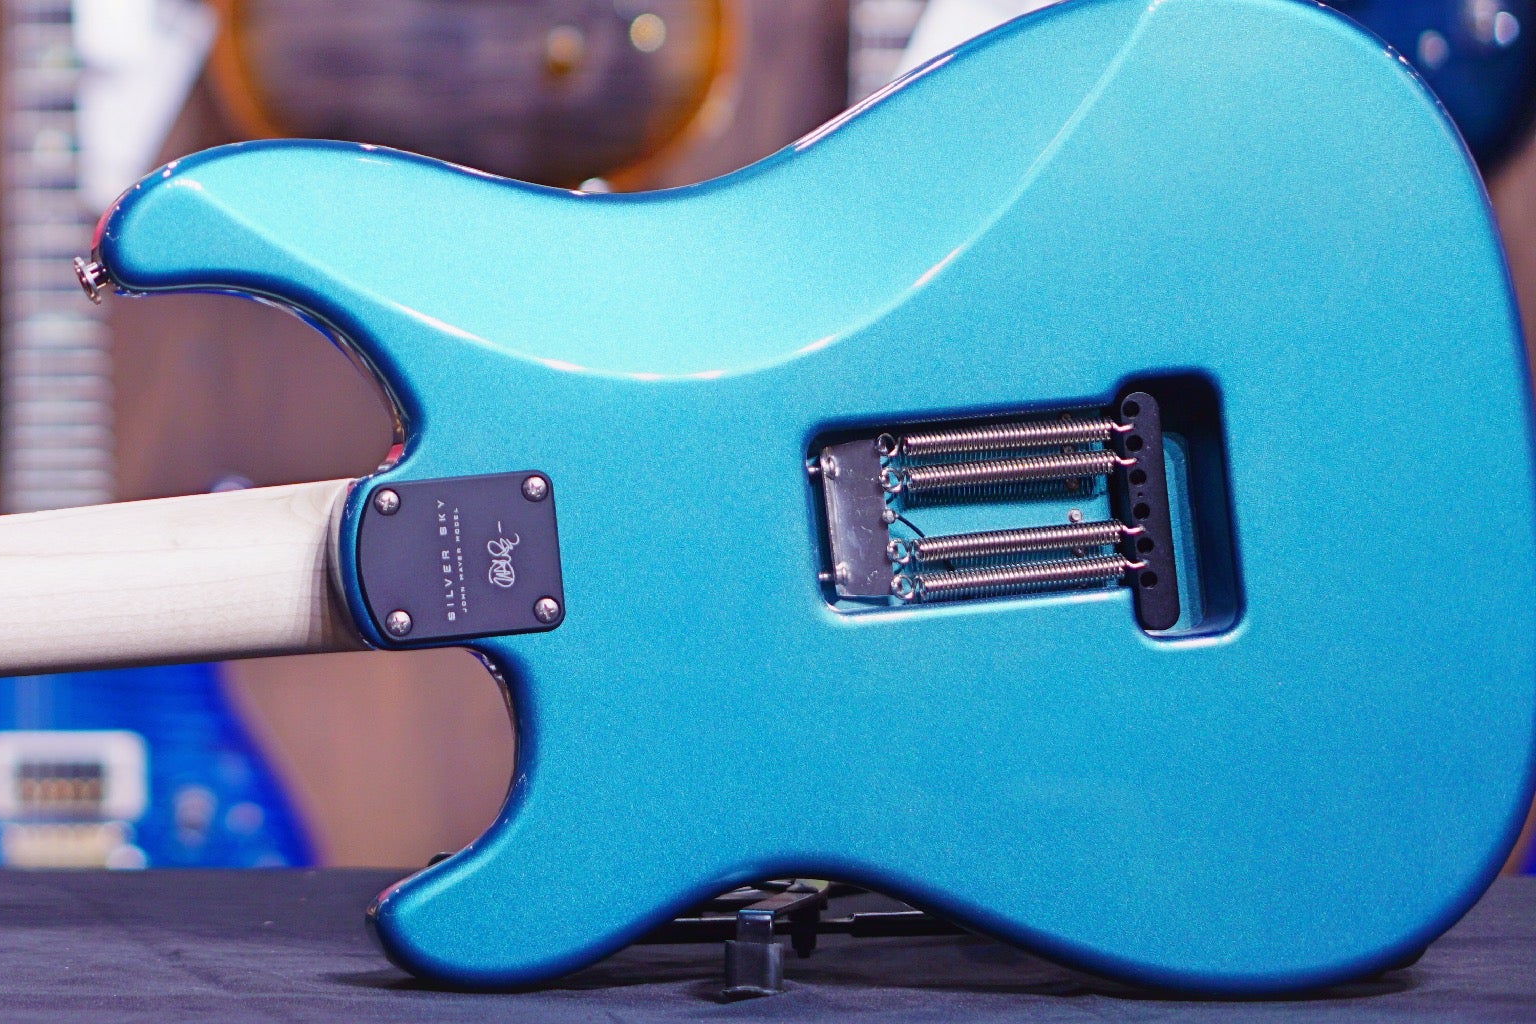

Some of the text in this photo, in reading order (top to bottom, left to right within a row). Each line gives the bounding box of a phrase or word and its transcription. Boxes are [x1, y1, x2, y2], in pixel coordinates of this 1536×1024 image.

[437, 500, 456, 621] SILVER SKY
[456, 547, 464, 580] MAYER
